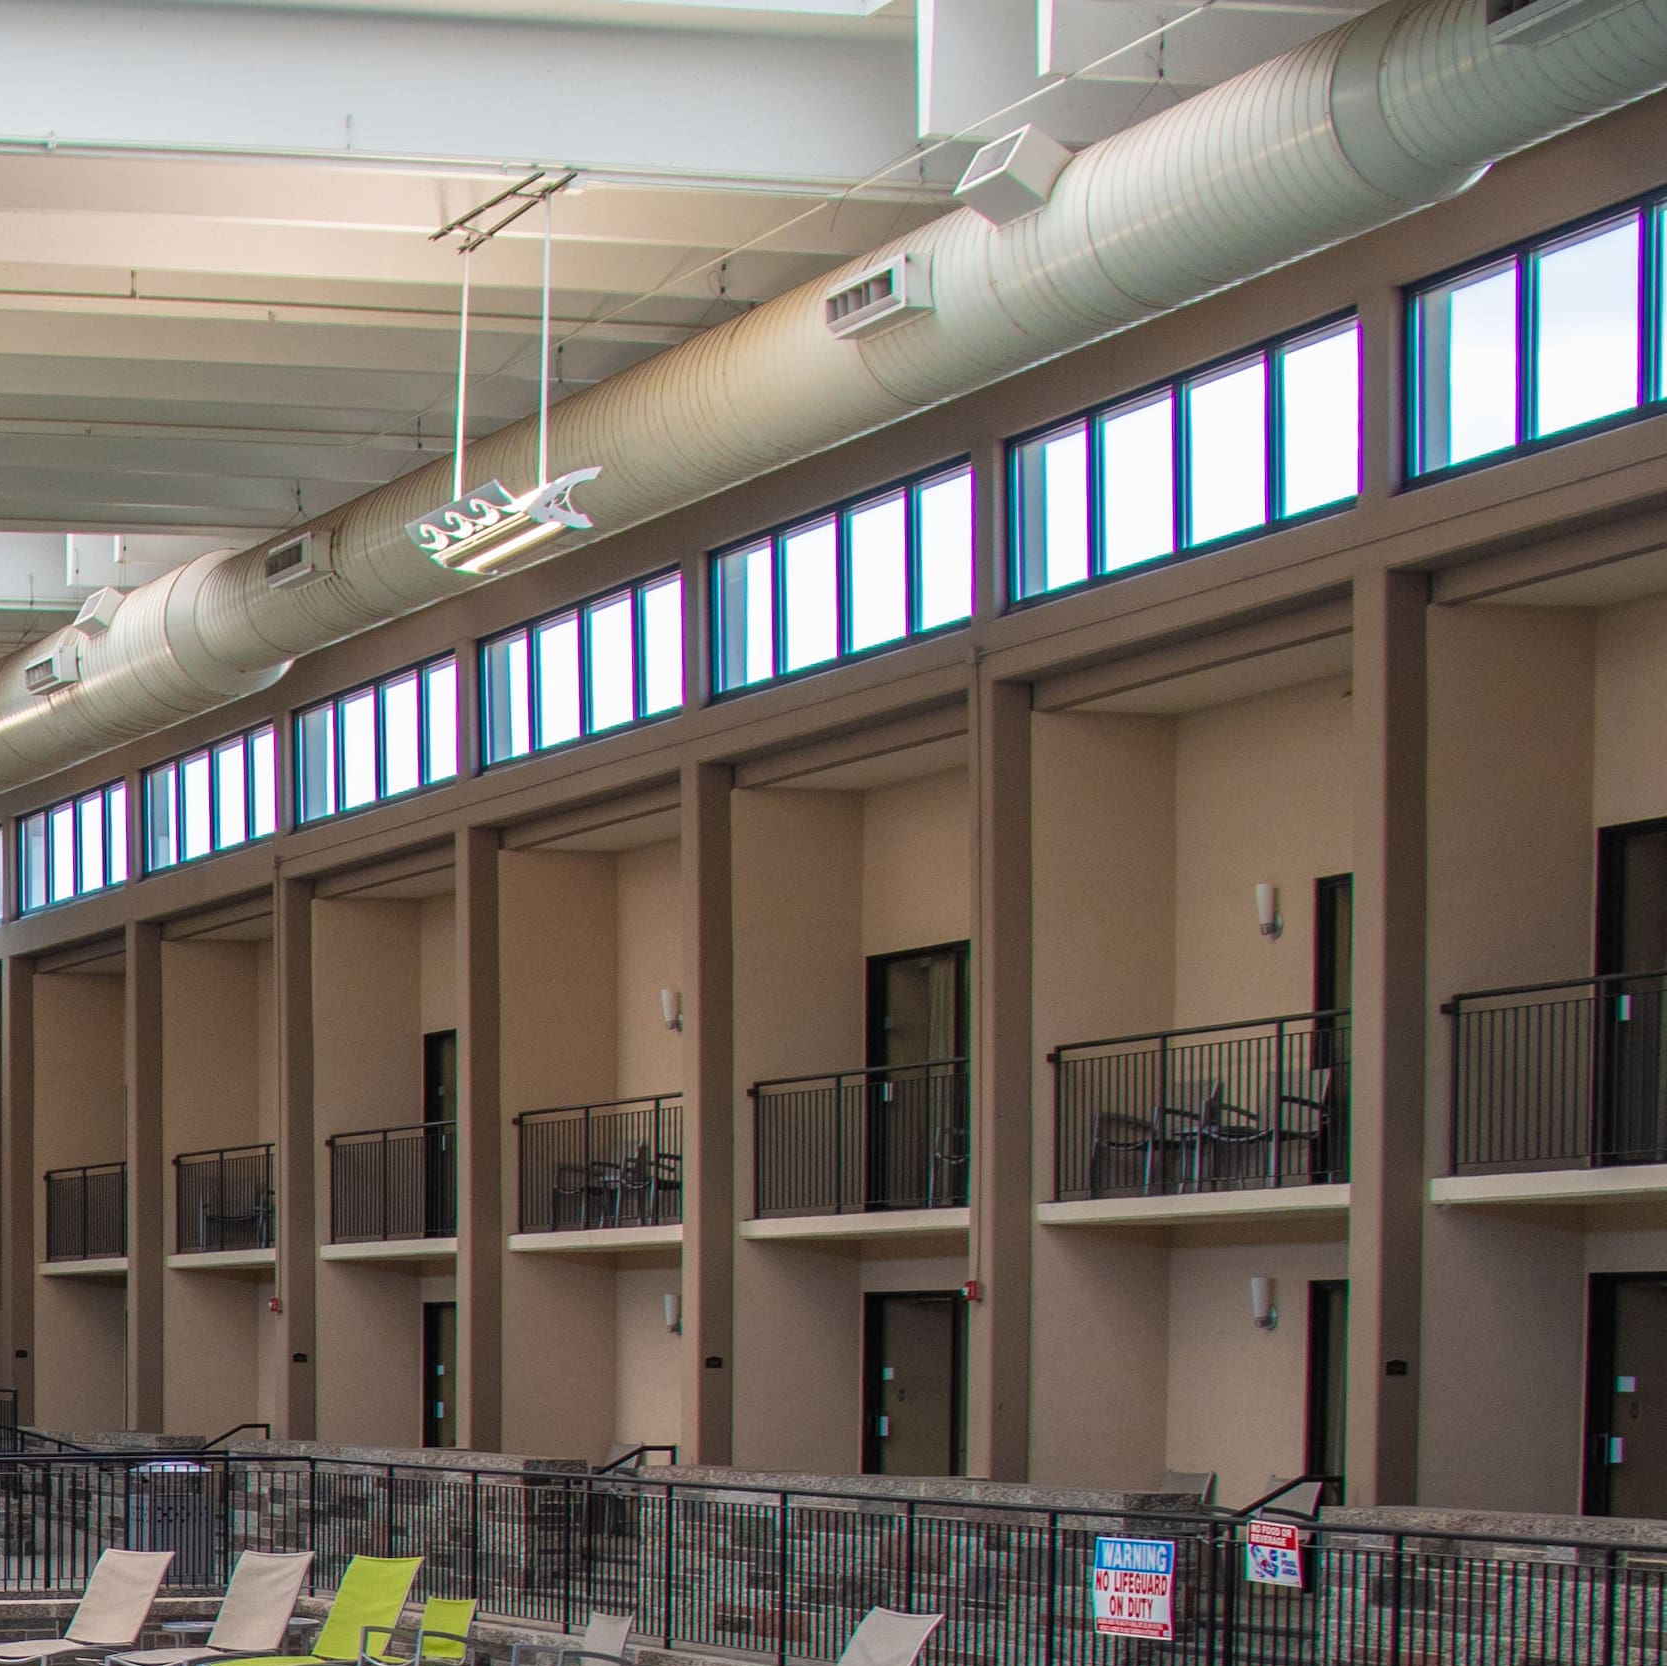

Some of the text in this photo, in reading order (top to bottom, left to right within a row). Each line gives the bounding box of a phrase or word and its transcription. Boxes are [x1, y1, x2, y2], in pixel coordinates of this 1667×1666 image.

[1251, 1524, 1261, 1533] NO
[1262, 1525, 1281, 1536] FOOD
[1251, 1534, 1287, 1547] BEVERAGE
[1102, 1542, 1168, 1572] WARNING
[1096, 1570, 1168, 1596] NO LIFEGUARD
[1109, 1595, 1153, 1619] ON DUTY
